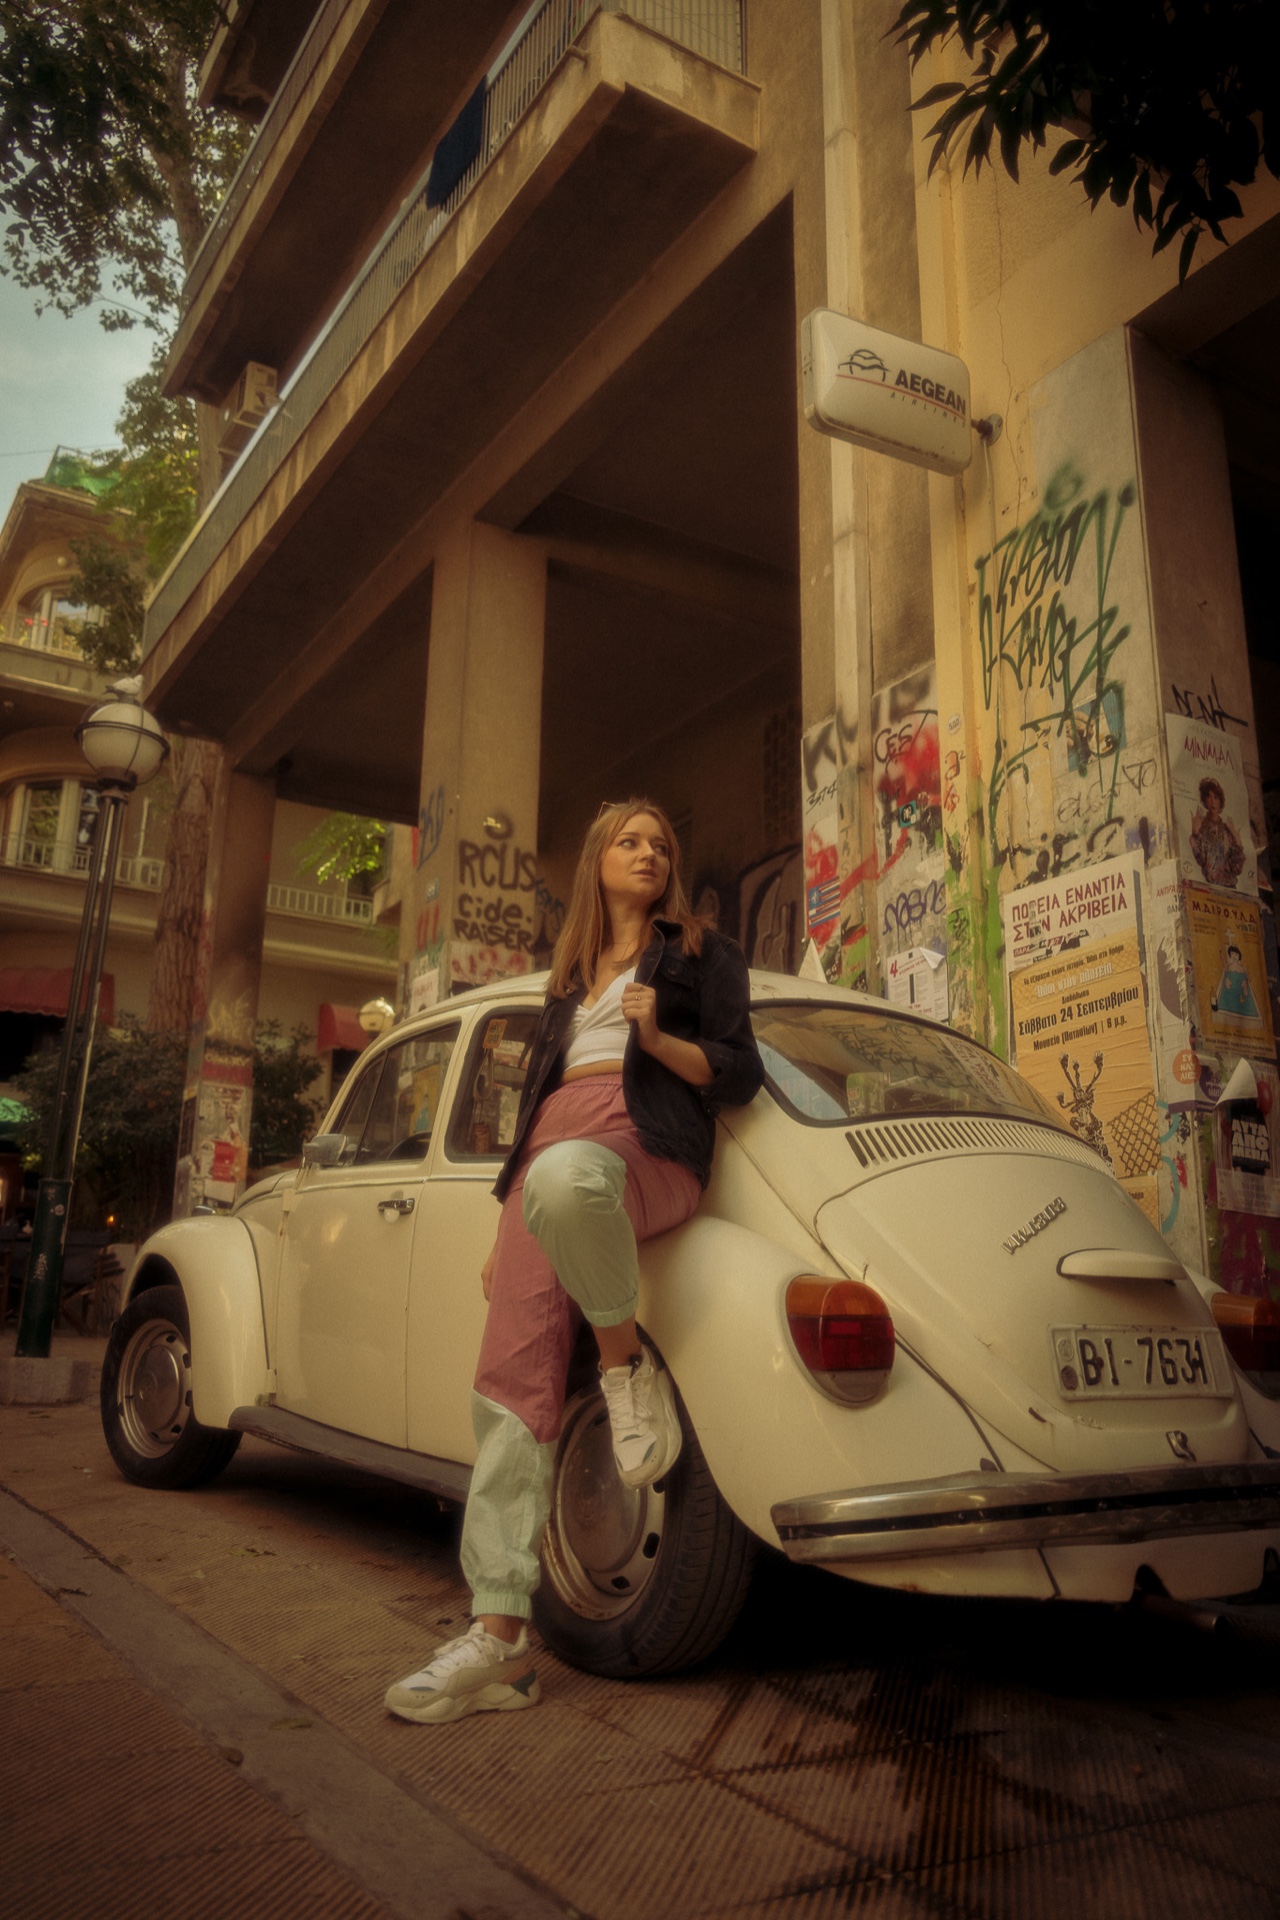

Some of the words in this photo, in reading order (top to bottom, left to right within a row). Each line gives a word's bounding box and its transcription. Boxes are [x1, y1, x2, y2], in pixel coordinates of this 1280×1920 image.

[895, 369, 967, 416] AEGEAN
[1012, 893, 1060, 922] ΠΟΕΙΑ
[1066, 872, 1126, 906] ΕΝΑΝΤΙΑ
[1013, 915, 1051, 942] ΣΤΝ
[1059, 892, 1127, 928] ΑΚΡΙΒΕΙΑ
[889, 960, 899, 978] 4
[1018, 1014, 1058, 1036] Σάββατο
[1060, 1006, 1073, 1023] 24
[1077, 987, 1139, 1018] Σεπτεμβρίου
[1232, 1134, 1270, 1151] ΑΠΟ
